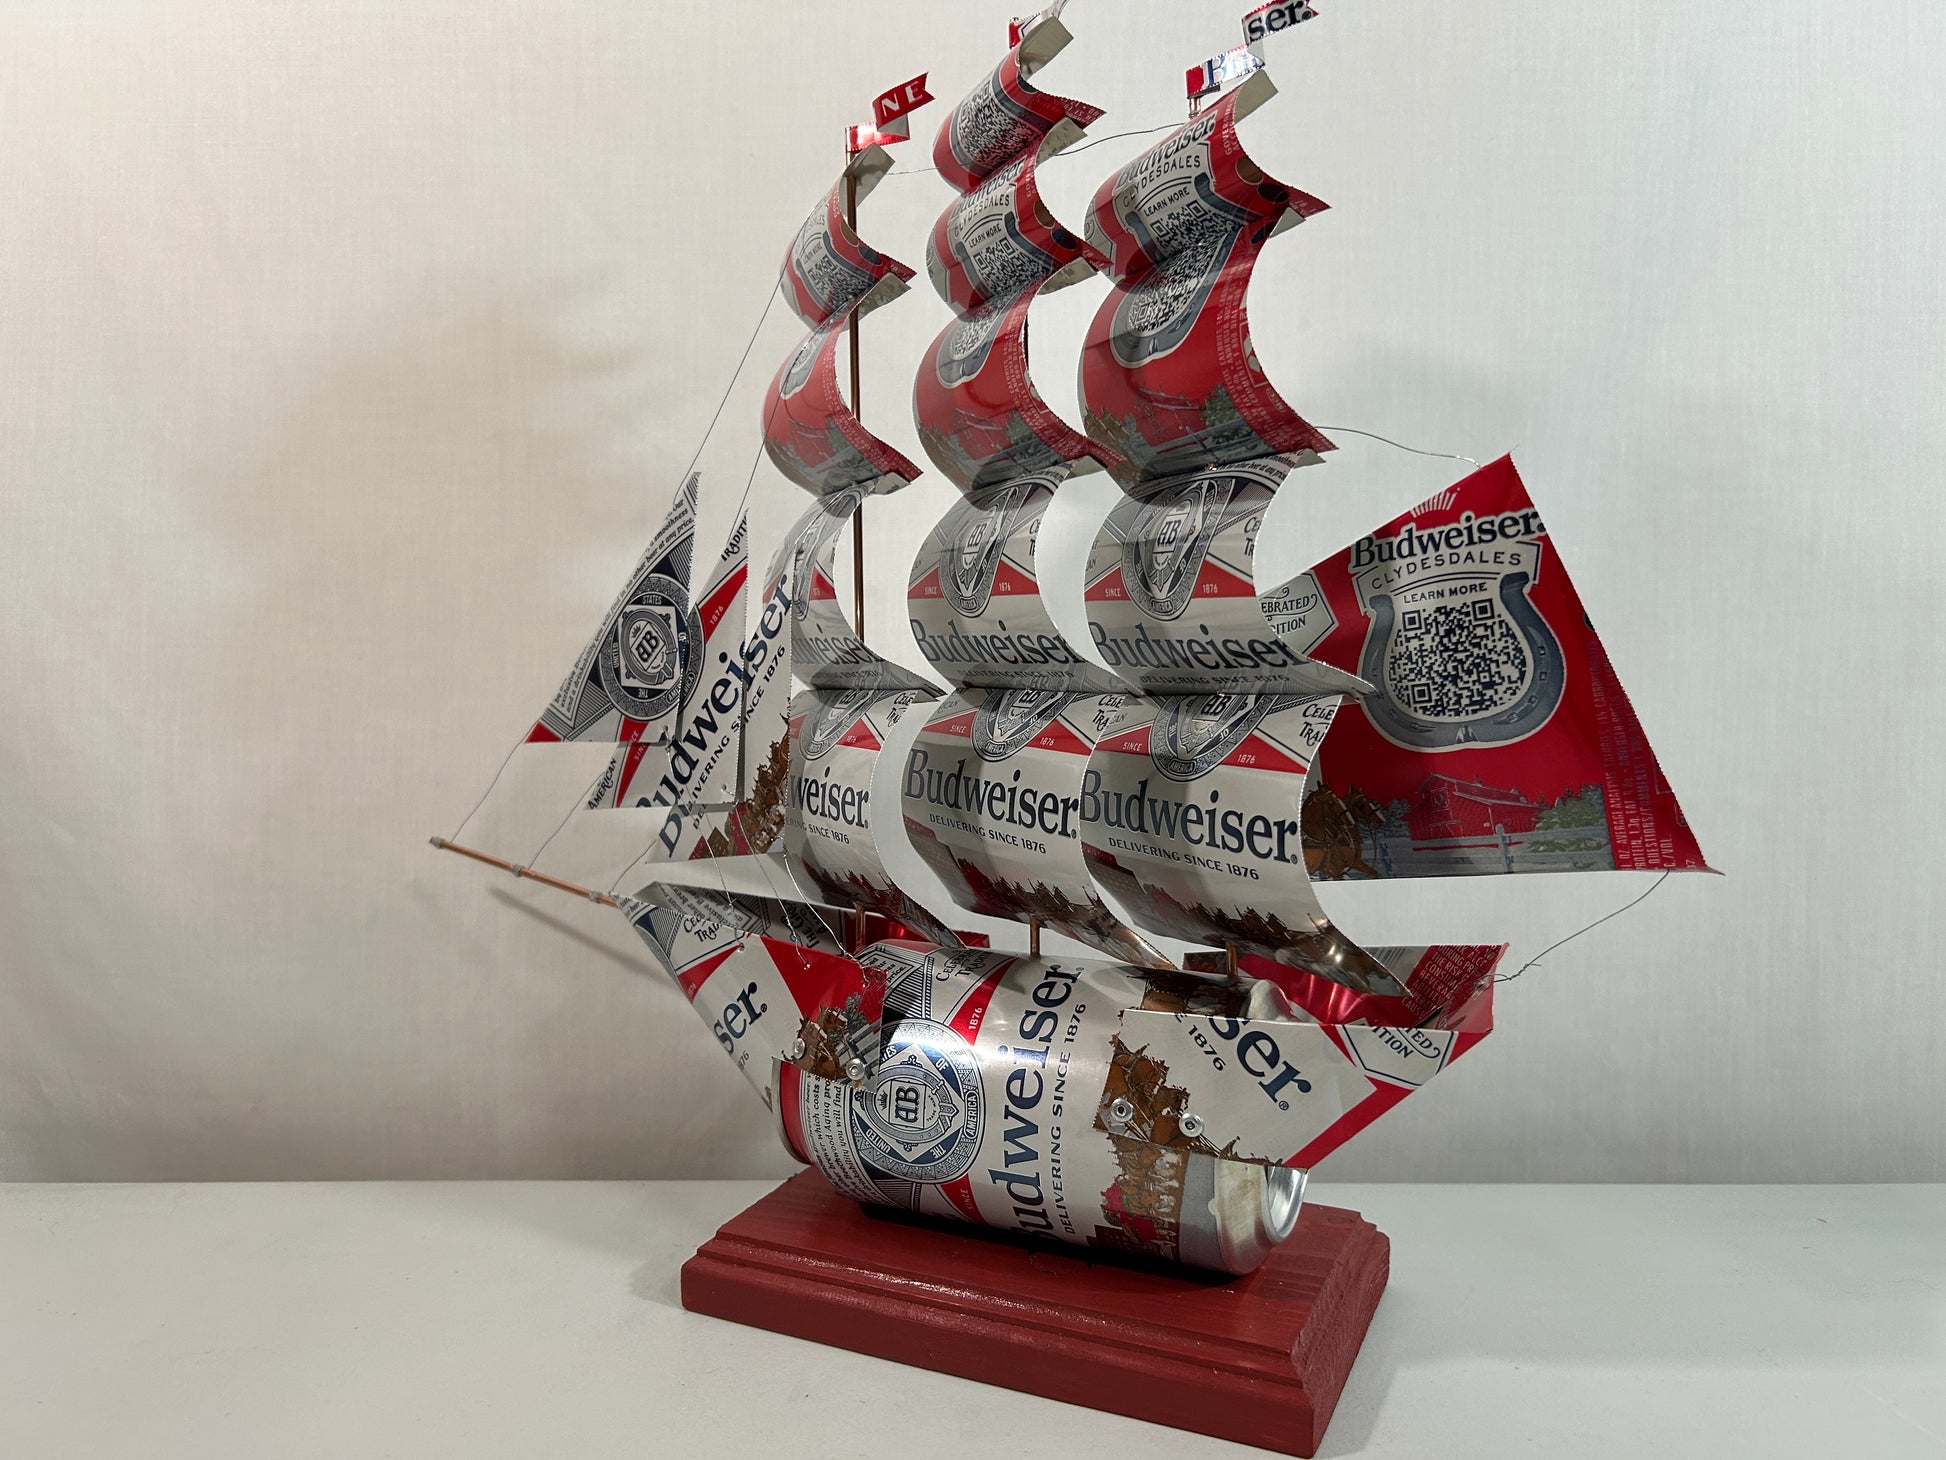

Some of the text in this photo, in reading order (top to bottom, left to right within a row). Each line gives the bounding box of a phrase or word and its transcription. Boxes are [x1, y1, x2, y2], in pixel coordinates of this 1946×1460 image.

[1122, 155, 1201, 208] CLYDESDALES
[953, 194, 1010, 238] CLYDESDALES
[1143, 186, 1190, 217] LEARN MORE
[968, 223, 1002, 248] LEARN MORE
[644, 548, 658, 563] beer
[657, 541, 665, 549] at
[664, 530, 677, 544] any
[1371, 551, 1522, 589] CLYDESDALES
[642, 595, 662, 605] STATES
[1105, 584, 1218, 597] SINCE 1876
[1403, 581, 1488, 604] LEARN MORE
[709, 605, 724, 626] 1876
[1088, 621, 1311, 671] Budweiser
[763, 644, 785, 683] 1876
[951, 724, 966, 734] SINCE
[1040, 736, 1055, 746] 1876
[1122, 741, 1142, 751] SINCE
[1237, 753, 1256, 764] 1876
[587, 758, 617, 810] AMERICAN
[809, 823, 850, 844] SINCE 1876
[929, 813, 1046, 854] DELIVERING SINCE 1876
[1109, 837, 1260, 880] DELIVERING SINCE 1876
[1443, 961, 1464, 980] RISK
[968, 1007, 983, 1030] 1876
[1187, 1024, 1226, 1072] 1876
[823, 1101, 832, 1131] Aging
[865, 1128, 891, 1154] UNITED
[935, 1057, 949, 1072] OF
[965, 1094, 979, 1136] AMERICA
[1049, 1002, 1087, 1235] DELIVERING SINCE 1876
[812, 1113, 822, 1139] which
[836, 1129, 846, 1146] you
[930, 1144, 945, 1160] THE
[960, 1188, 974, 1210] SINCE
